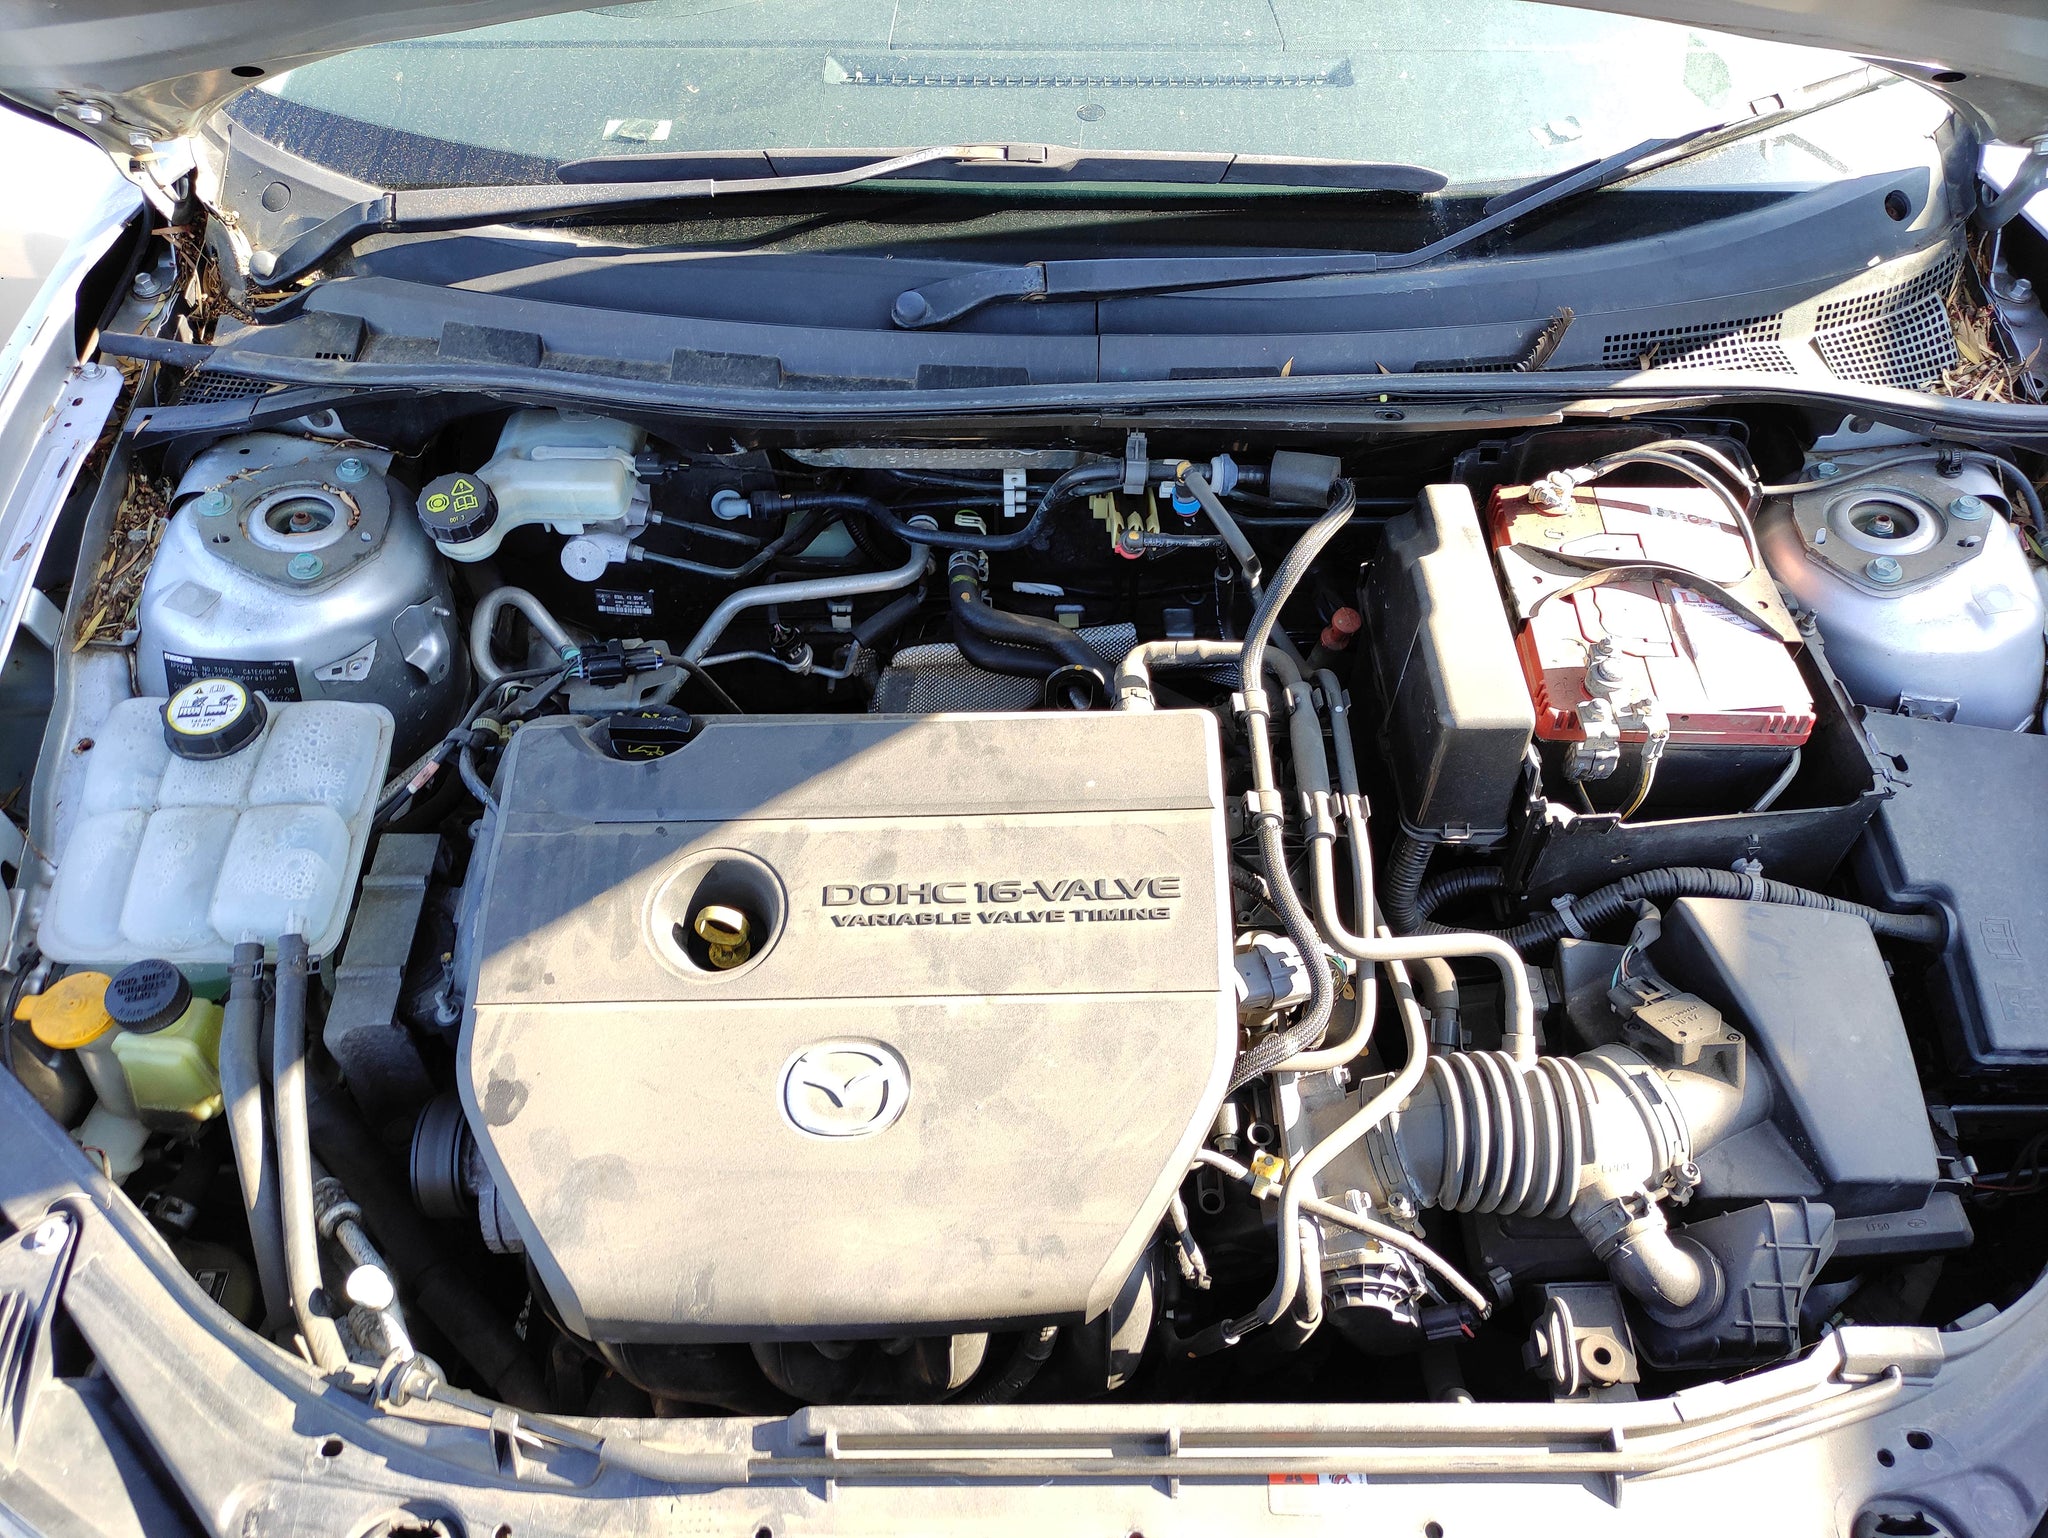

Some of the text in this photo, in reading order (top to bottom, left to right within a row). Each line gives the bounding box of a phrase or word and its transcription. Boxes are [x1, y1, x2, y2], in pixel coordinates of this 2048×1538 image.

[242, 668, 276, 676] CATEGORY
[822, 876, 1182, 907] DOHC 16-VALVE
[831, 907, 1171, 928] VARIABLE VALVE TIMING
